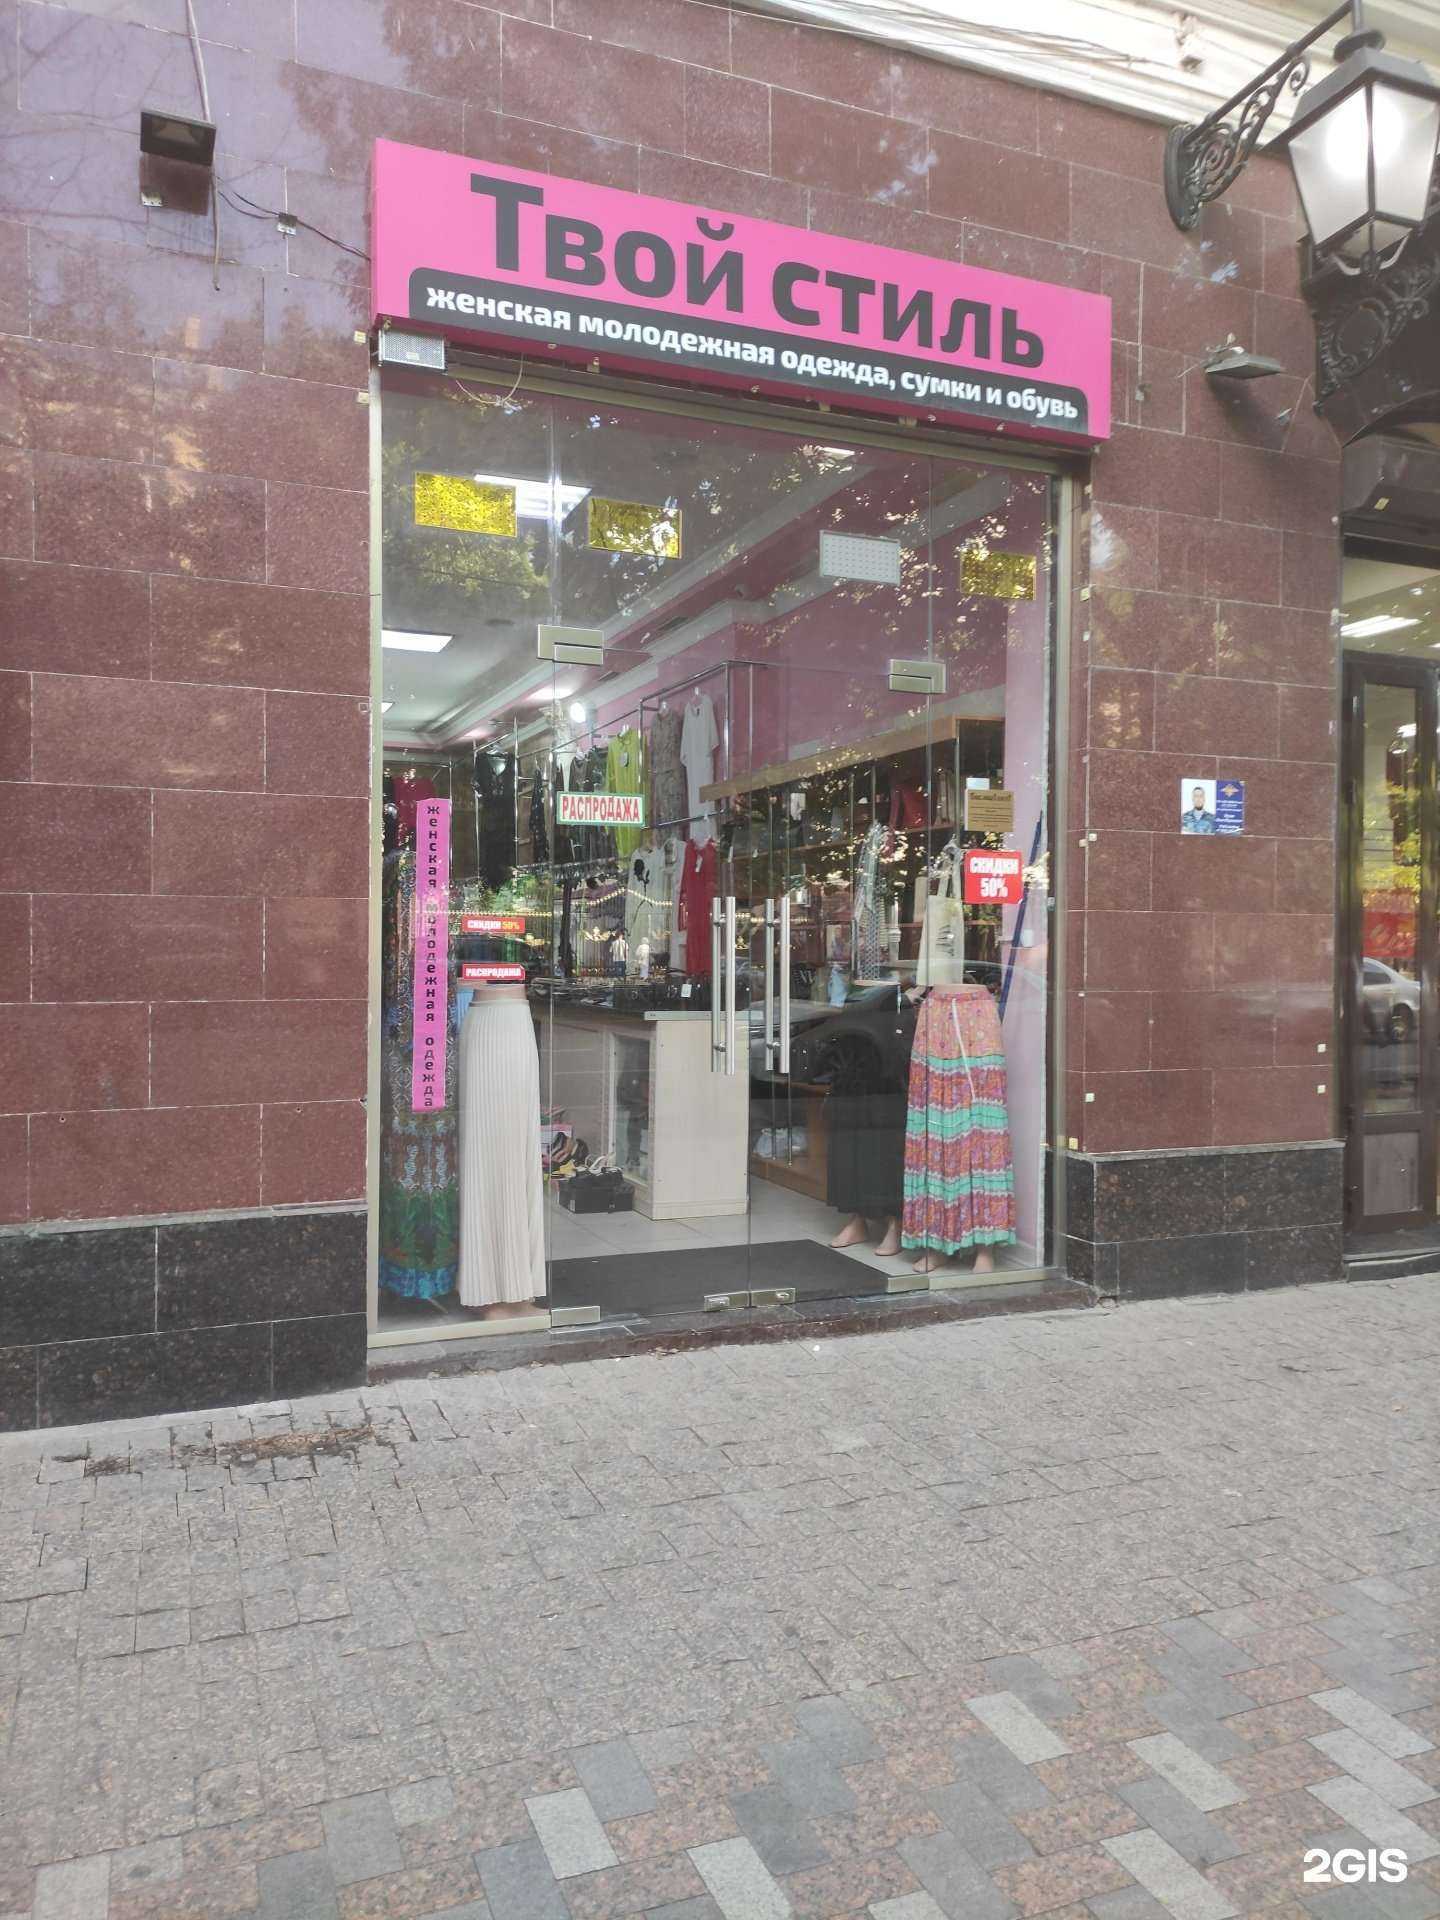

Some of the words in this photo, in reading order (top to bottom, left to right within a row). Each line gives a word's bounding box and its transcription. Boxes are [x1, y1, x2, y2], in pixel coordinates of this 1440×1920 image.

[470, 173, 744, 313] Твой
[772, 262, 1045, 368] стиль
[426, 287, 572, 331] женская
[578, 314, 775, 366] молодежная
[780, 350, 896, 391] одежда,
[900, 371, 982, 402] сумки
[985, 386, 1002, 406] и
[1006, 388, 1079, 419] обувь
[562, 796, 640, 821] РАСПРОДАЖА
[980, 877, 1008, 897] 50%
